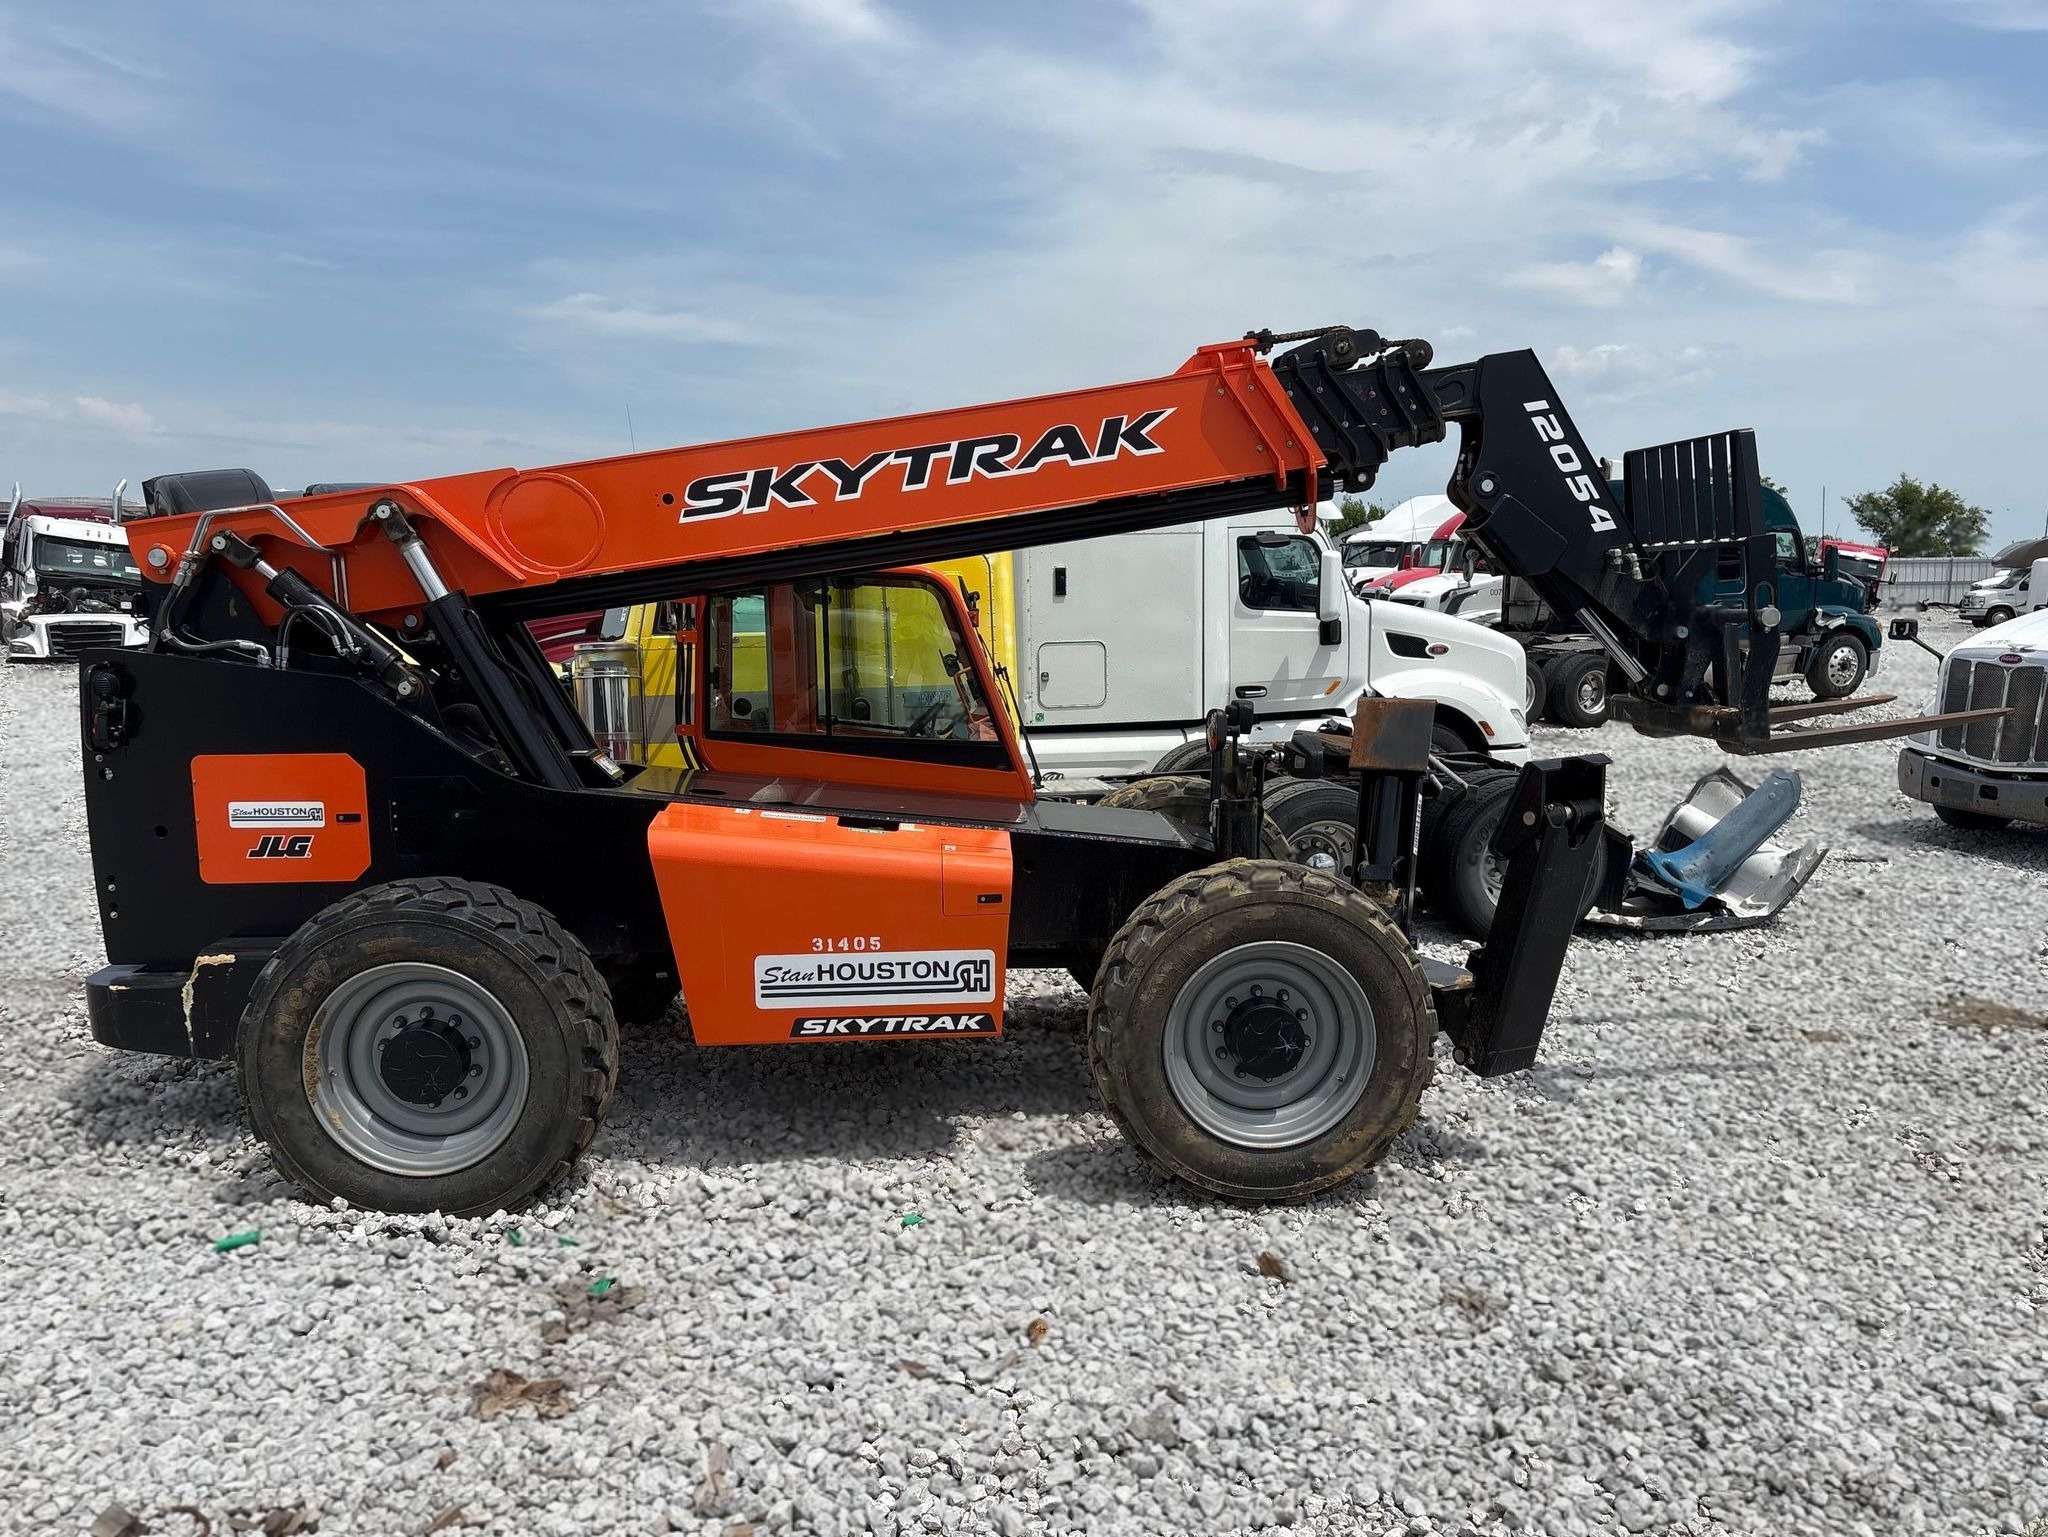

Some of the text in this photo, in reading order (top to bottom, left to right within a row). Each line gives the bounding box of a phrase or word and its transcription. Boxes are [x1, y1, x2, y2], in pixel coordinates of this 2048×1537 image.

[679, 406, 1179, 524] SKYTRAK
[1523, 399, 1617, 533] 12054
[231, 808, 253, 816] Stan
[253, 807, 307, 816] HOUSTON
[246, 835, 314, 859] JLG
[812, 936, 881, 952] 31405
[760, 966, 816, 984] Stan
[817, 960, 950, 982] HOUSTON
[800, 1014, 986, 1035] SKYTRAK
